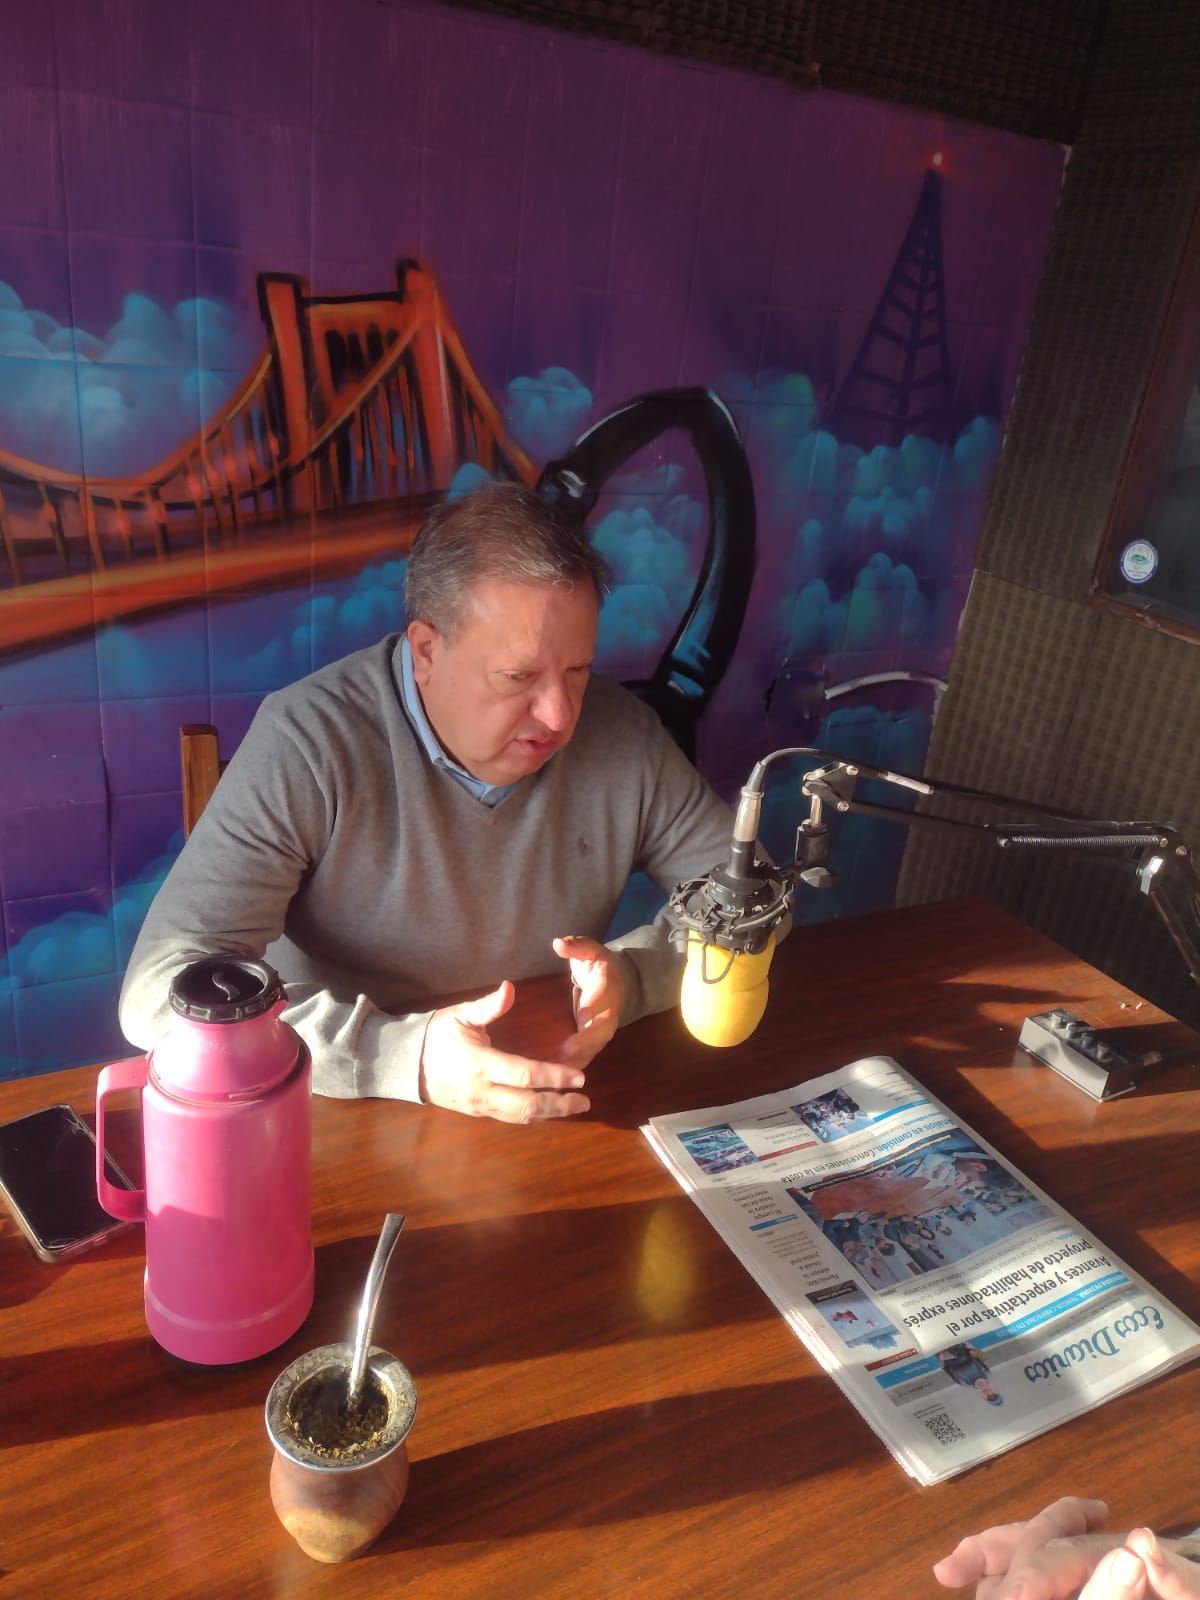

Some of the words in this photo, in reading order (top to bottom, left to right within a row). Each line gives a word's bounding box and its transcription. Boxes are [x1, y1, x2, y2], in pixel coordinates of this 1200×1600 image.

[812, 1164, 826, 1172] en
[824, 1148, 876, 1169] Concesiones
[779, 1171, 804, 1183] costa
[803, 1168, 815, 1176] la
[1042, 1238, 1093, 1265] proyecto
[1026, 1260, 1045, 1274] de
[1053, 1271, 1067, 1284] y
[1066, 1256, 1110, 1278] Avances
[944, 1268, 1032, 1310] habilitaciones
[980, 1278, 1057, 1319] expectativas
[902, 1304, 946, 1328] exprés
[959, 1310, 983, 1328] por
[1113, 1305, 1164, 1338] Ecos
[947, 1322, 960, 1336] el
[1023, 1326, 1120, 1382] Diarios
